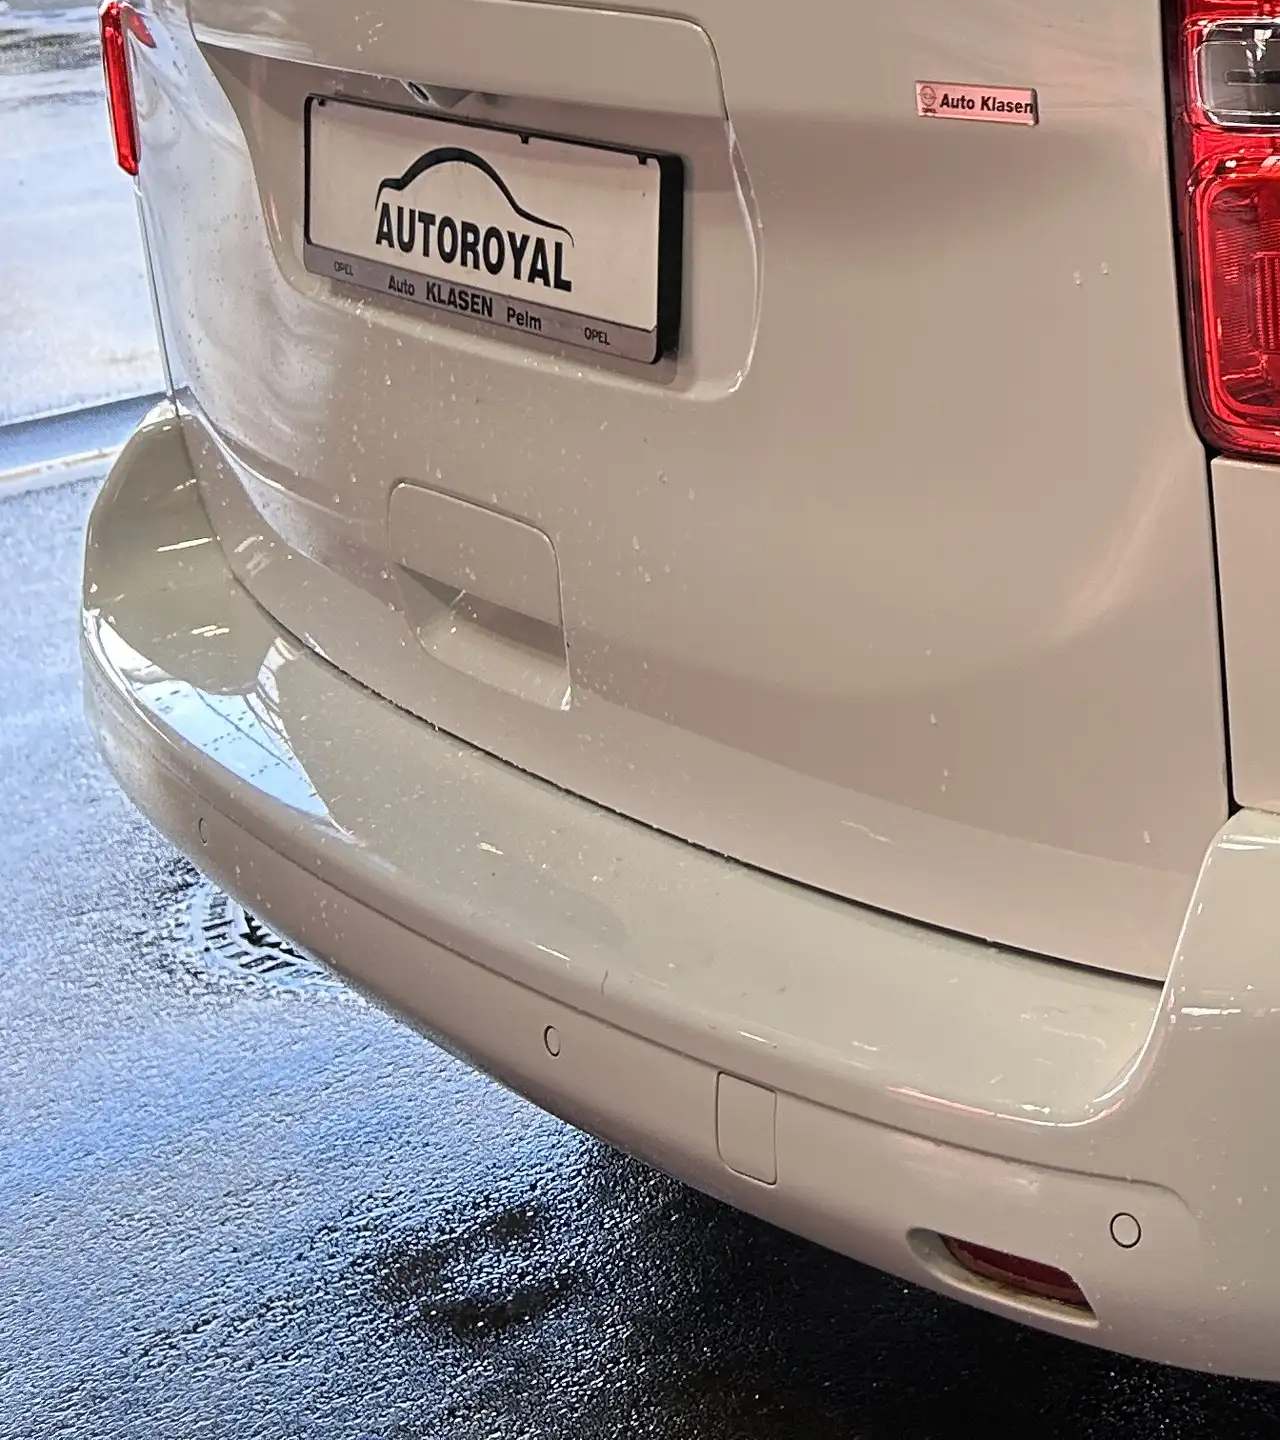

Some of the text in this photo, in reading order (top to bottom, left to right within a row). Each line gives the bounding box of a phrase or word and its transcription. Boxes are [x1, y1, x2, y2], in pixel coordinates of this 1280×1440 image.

[941, 93, 1033, 114] Auto Klasen
[375, 202, 573, 292] AUTOROYAL
[388, 275, 543, 331] Auto KLASEN Pelm
[584, 327, 611, 346] OPEL
